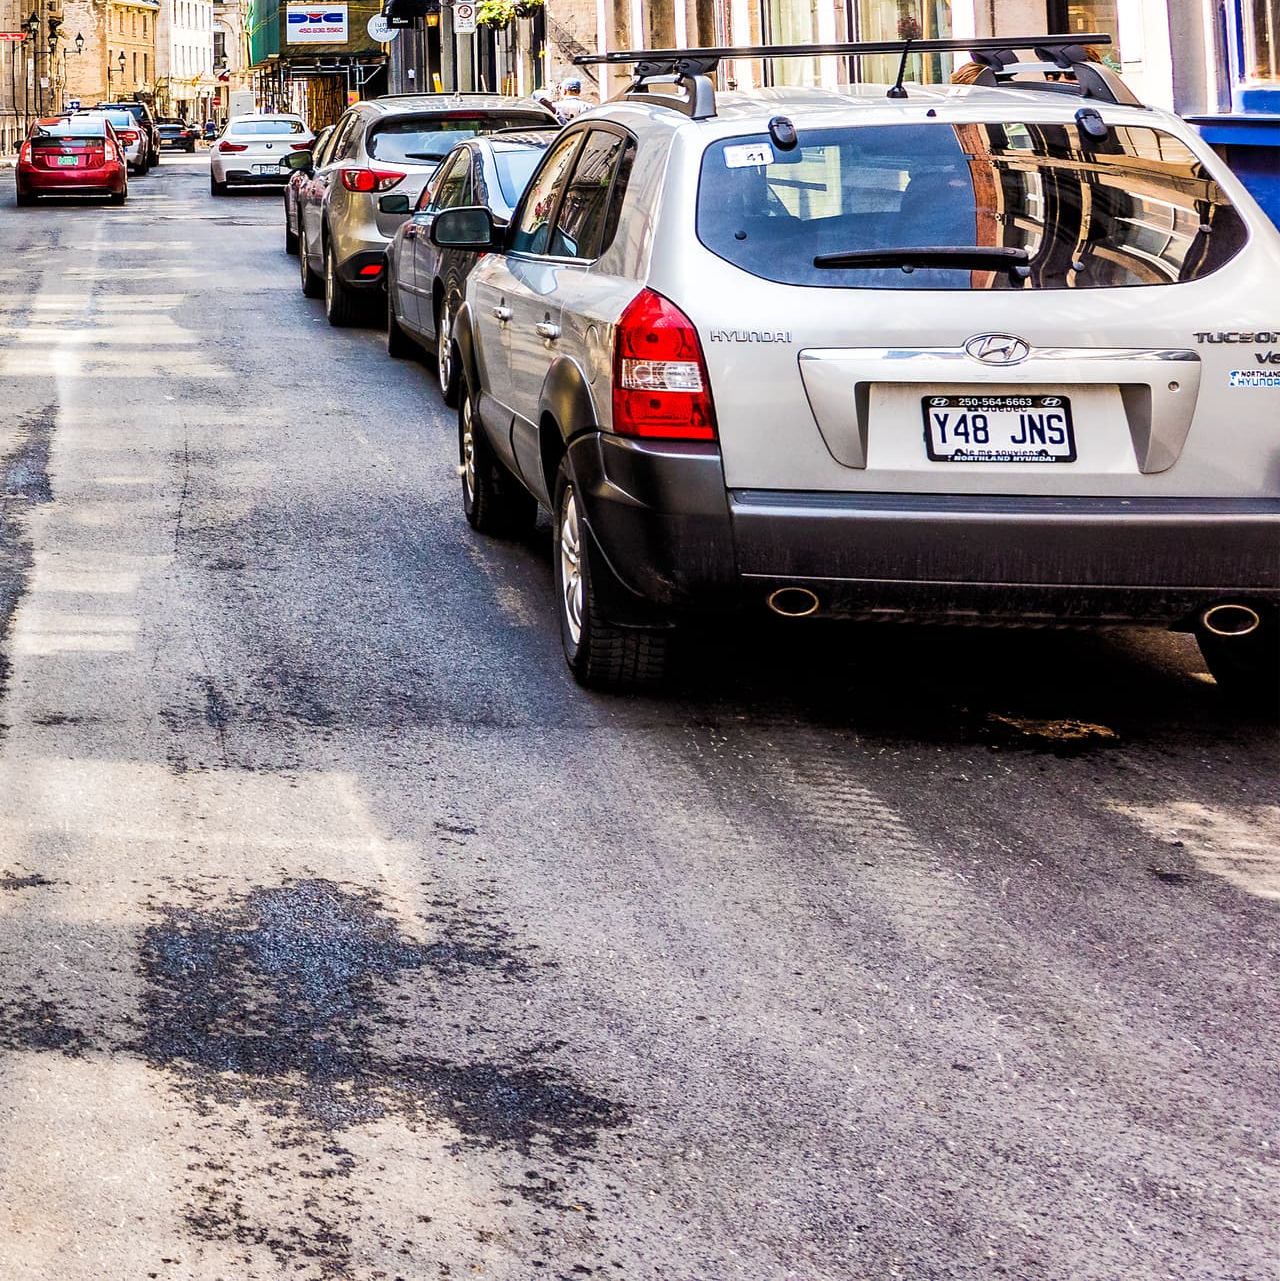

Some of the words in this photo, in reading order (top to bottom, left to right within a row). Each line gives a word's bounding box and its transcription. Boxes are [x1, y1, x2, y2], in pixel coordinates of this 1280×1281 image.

[710, 330, 792, 343] HYUNDAI
[958, 398, 1033, 406] 250-564-6663
[934, 413, 990, 444] Y48
[1010, 414, 1066, 445] JNS
